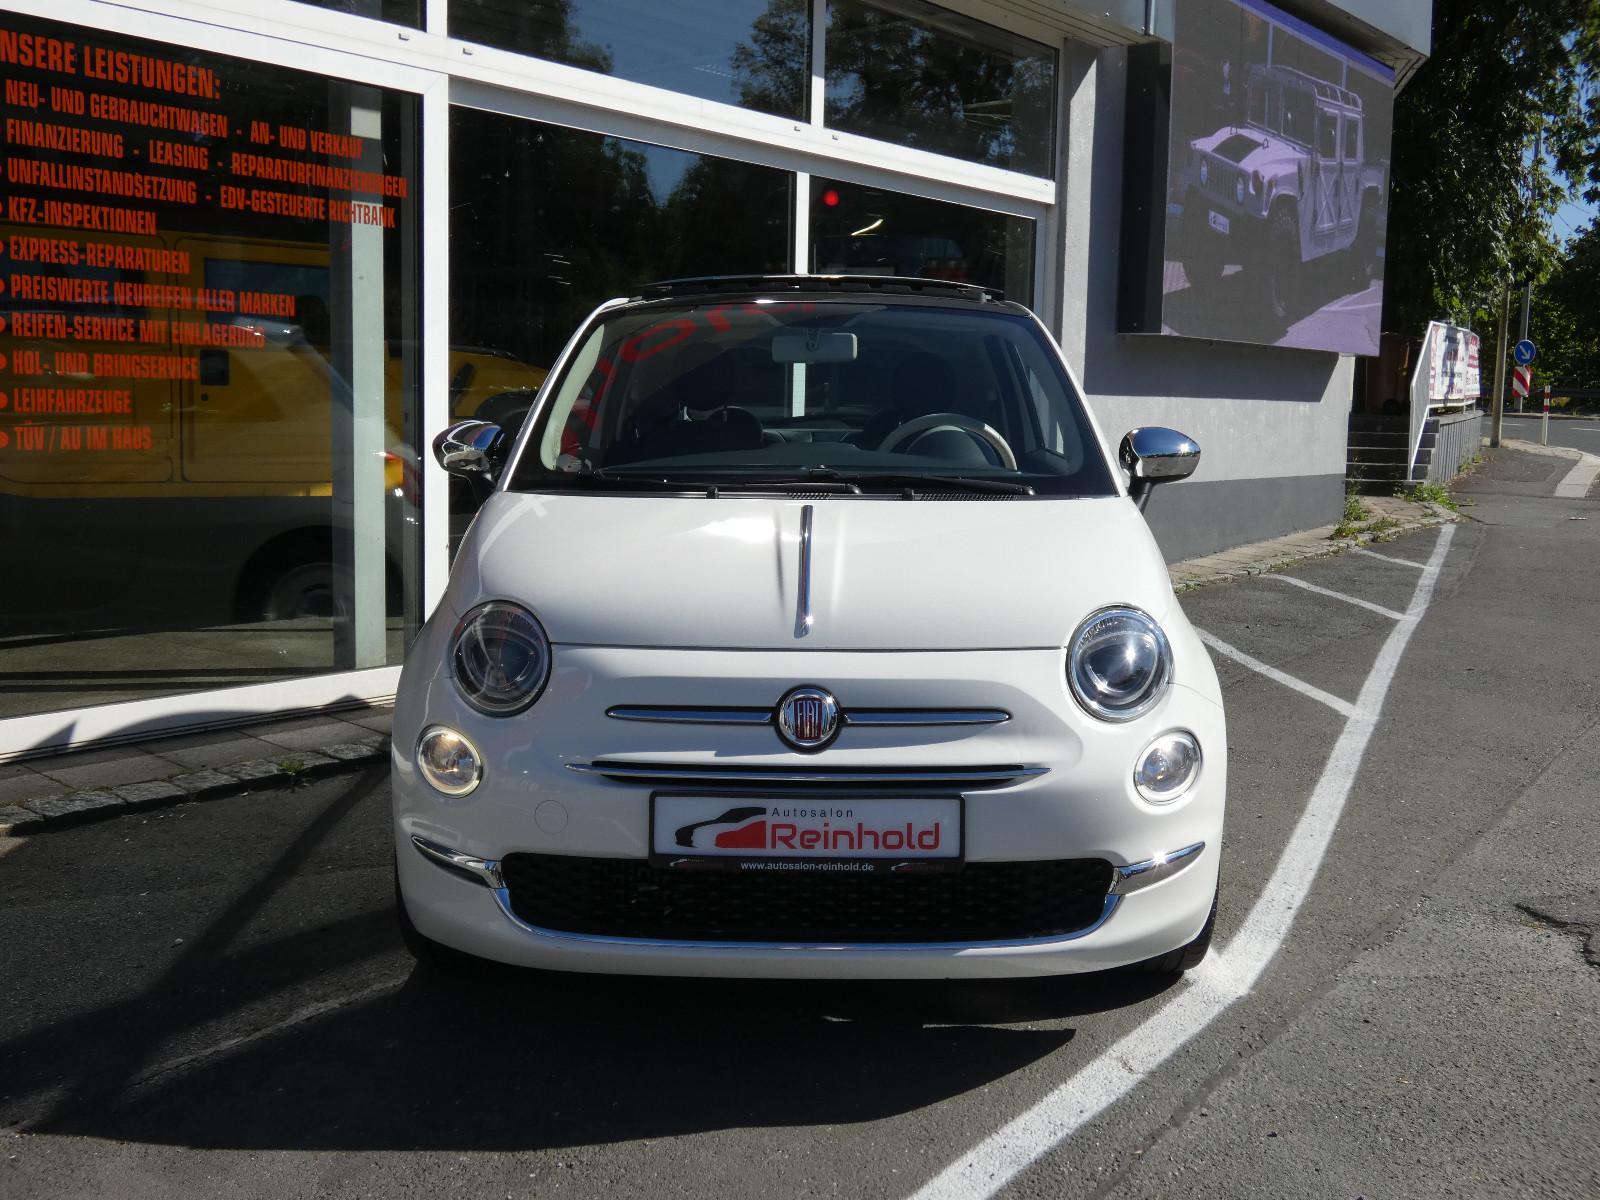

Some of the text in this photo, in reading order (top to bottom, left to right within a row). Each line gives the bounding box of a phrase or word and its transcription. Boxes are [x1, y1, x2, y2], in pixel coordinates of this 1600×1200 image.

[83, 45, 221, 99] LEISTUNGEN:
[5, 79, 46, 109] NEU-
[51, 86, 85, 116] UND
[90, 93, 228, 139] GEBRAUCHTWAGEN
[250, 120, 276, 145] AN-
[279, 125, 307, 150] UND
[310, 130, 364, 160] VERKAUF
[6, 118, 124, 159] FINANZIERUNG
[149, 140, 209, 171] LEASING
[231, 151, 407, 198] REPARATURFINANZIERUNGEN
[7, 157, 197, 205] UNFALLINSTANDSETZUNG
[220, 185, 325, 220] EDV-GESTEUERTE
[328, 200, 395, 228] RICHTBANK
[8, 196, 157, 236] KFZ-INSPEKTIONEN
[9, 235, 190, 275] EXPRESS-REPARATUREN
[10, 273, 296, 317] PREISWERTE NEUREIFEN ALLER MARKEN
[11, 312, 266, 349] REIFEN-SERVICE MIT EINLAGERUNG
[12, 349, 199, 380] HOL- UND BRINGSERVICE
[13, 387, 132, 414] LEIHFAHRZEUGE
[14, 419, 45, 450] TÜV
[59, 426, 82, 450] AU
[86, 427, 109, 449] IM
[112, 427, 153, 450] HAUS
[797, 700, 821, 738] FIAT
[771, 807, 853, 818] Autosalon
[770, 822, 940, 850] Reinhold
[740, 861, 875, 872] www.autosalon-reinhold.de
